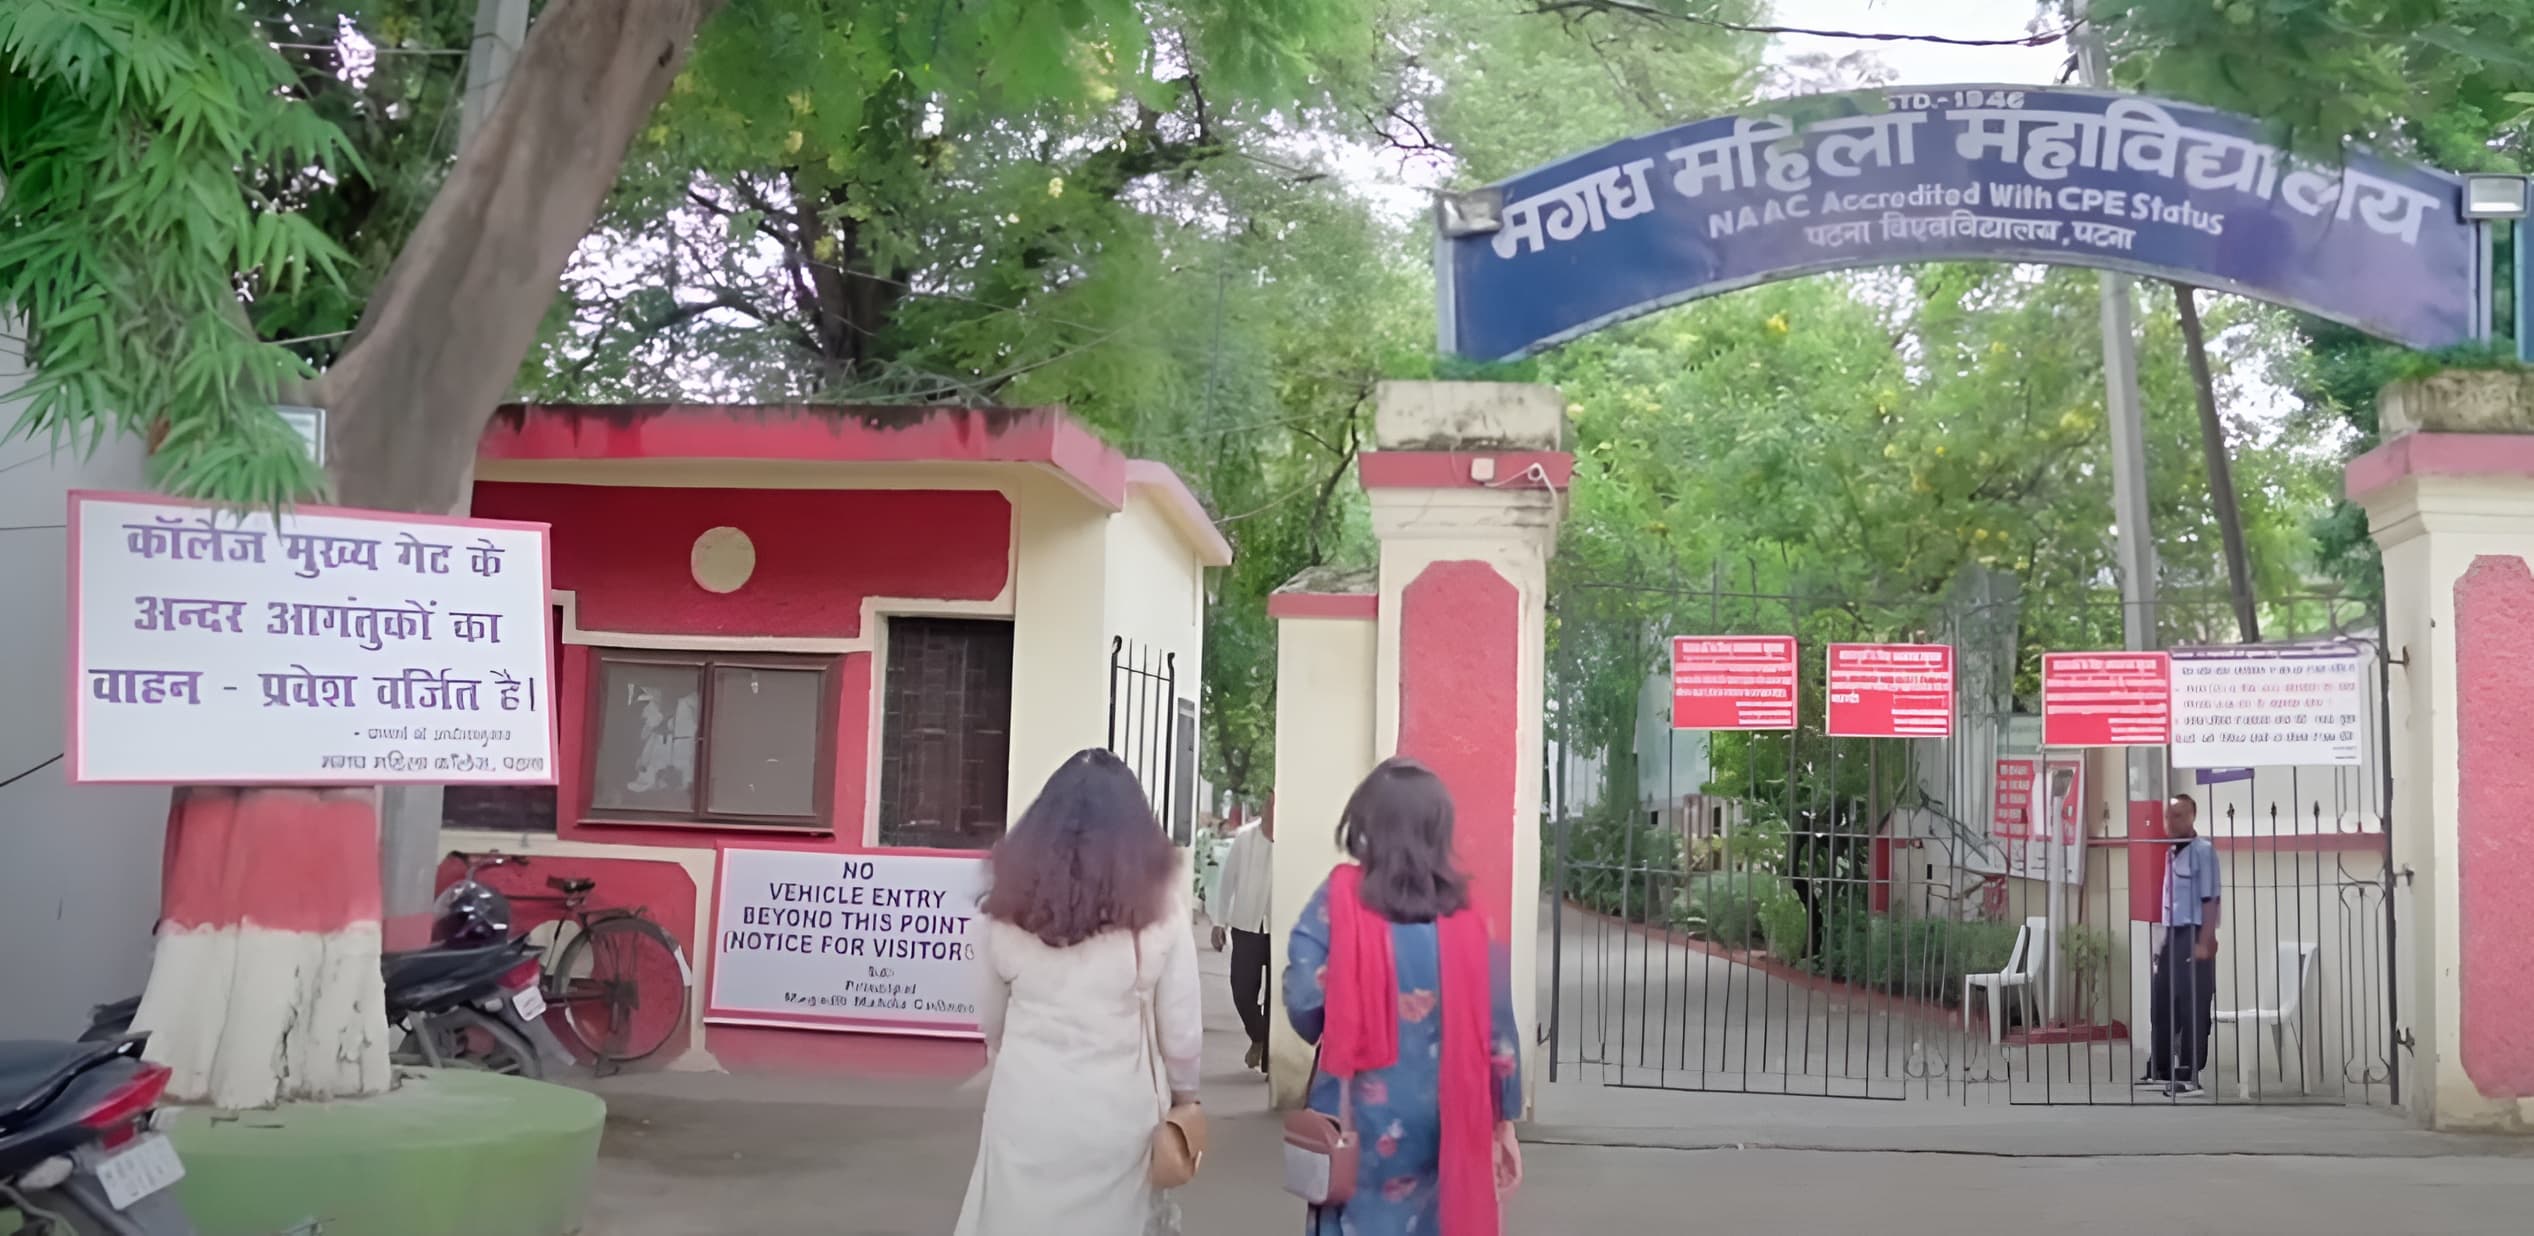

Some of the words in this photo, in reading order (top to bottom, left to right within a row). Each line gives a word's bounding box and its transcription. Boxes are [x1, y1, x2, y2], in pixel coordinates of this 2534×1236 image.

[1492, 157, 1656, 259] मगध
[1666, 111, 1928, 198] महिला
[1945, 98, 2441, 246] महाविद्यालय
[1708, 195, 1811, 239] NAAC
[1821, 182, 1981, 215] Accredited
[1989, 182, 2053, 210] With
[2057, 186, 2127, 216] CPE
[2131, 192, 2225, 236] Status
[1803, 220, 1873, 248] पटना
[122, 514, 267, 563] कॉलेज
[281, 534, 381, 579] मुख्य
[395, 532, 453, 575] गेट
[466, 538, 505, 577] के
[134, 596, 247, 632] अन्दर
[267, 597, 437, 651] आगंतुकों
[448, 611, 503, 643] का
[88, 669, 203, 704] वाहन
[257, 664, 358, 708] प्रवेश
[372, 668, 482, 711] वर्जित
[842, 861, 874, 880] NO
[770, 883, 864, 905] VEHICLE
[872, 888, 946, 909] ENTRY
[743, 906, 832, 928] BEYOND
[841, 912, 892, 932] THIS
[900, 914, 972, 936] POINT
[724, 931, 812, 953] (NOTICE
[822, 936, 864, 956] FOR
